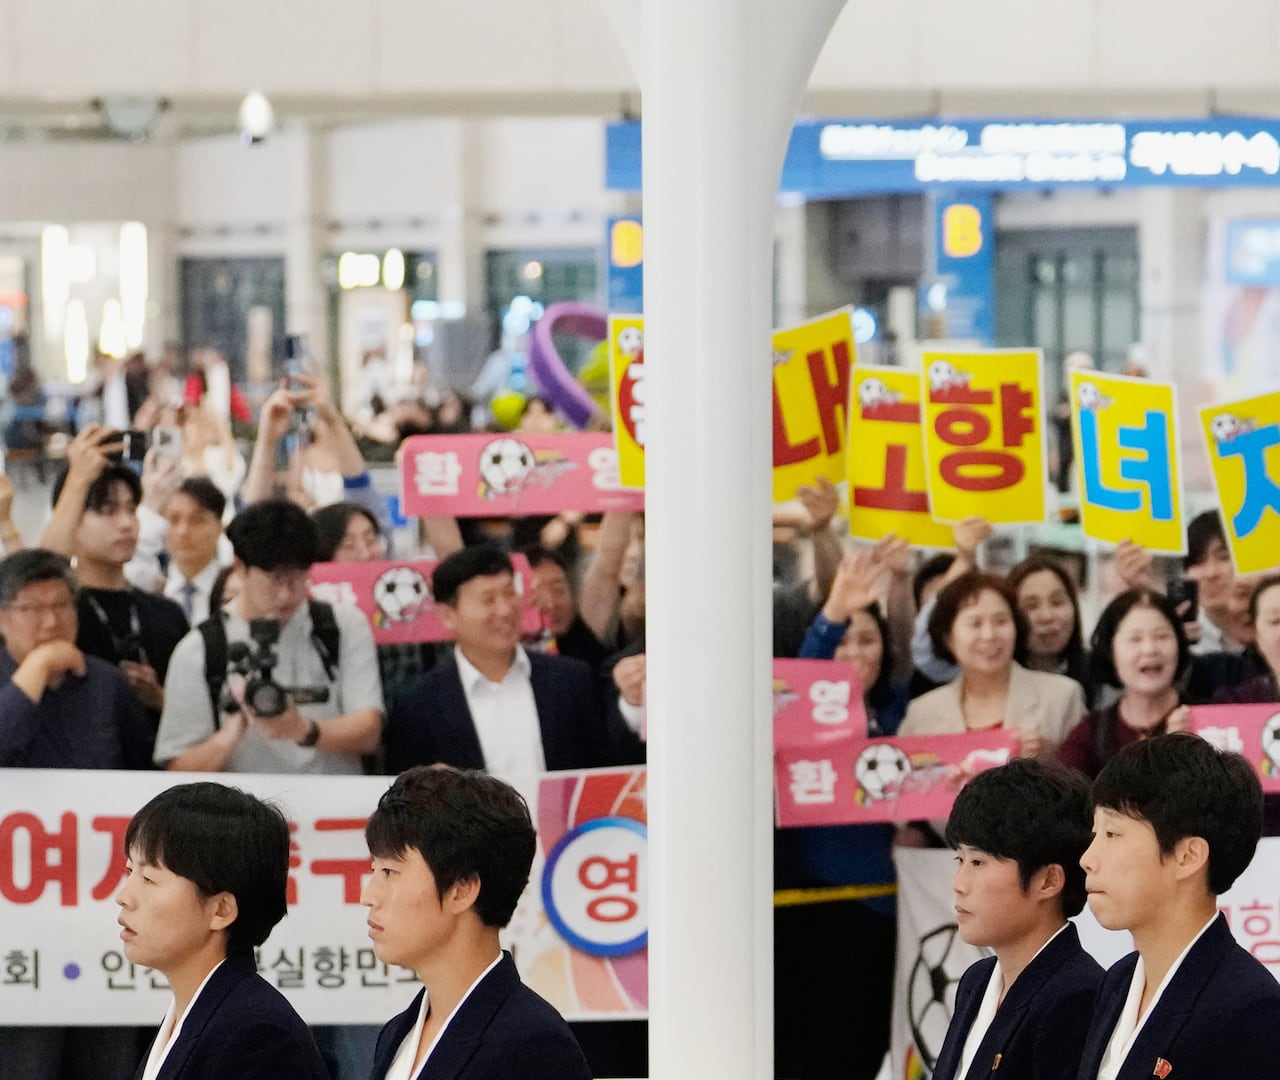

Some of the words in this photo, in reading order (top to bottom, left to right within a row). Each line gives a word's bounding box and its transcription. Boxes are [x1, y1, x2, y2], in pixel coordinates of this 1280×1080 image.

[943, 203, 983, 257] B
[773, 340, 852, 468] 내
[929, 381, 1036, 492] 향
[1079, 407, 1174, 521] 녀
[808, 679, 851, 725] 영
[577, 854, 640, 924] 영
